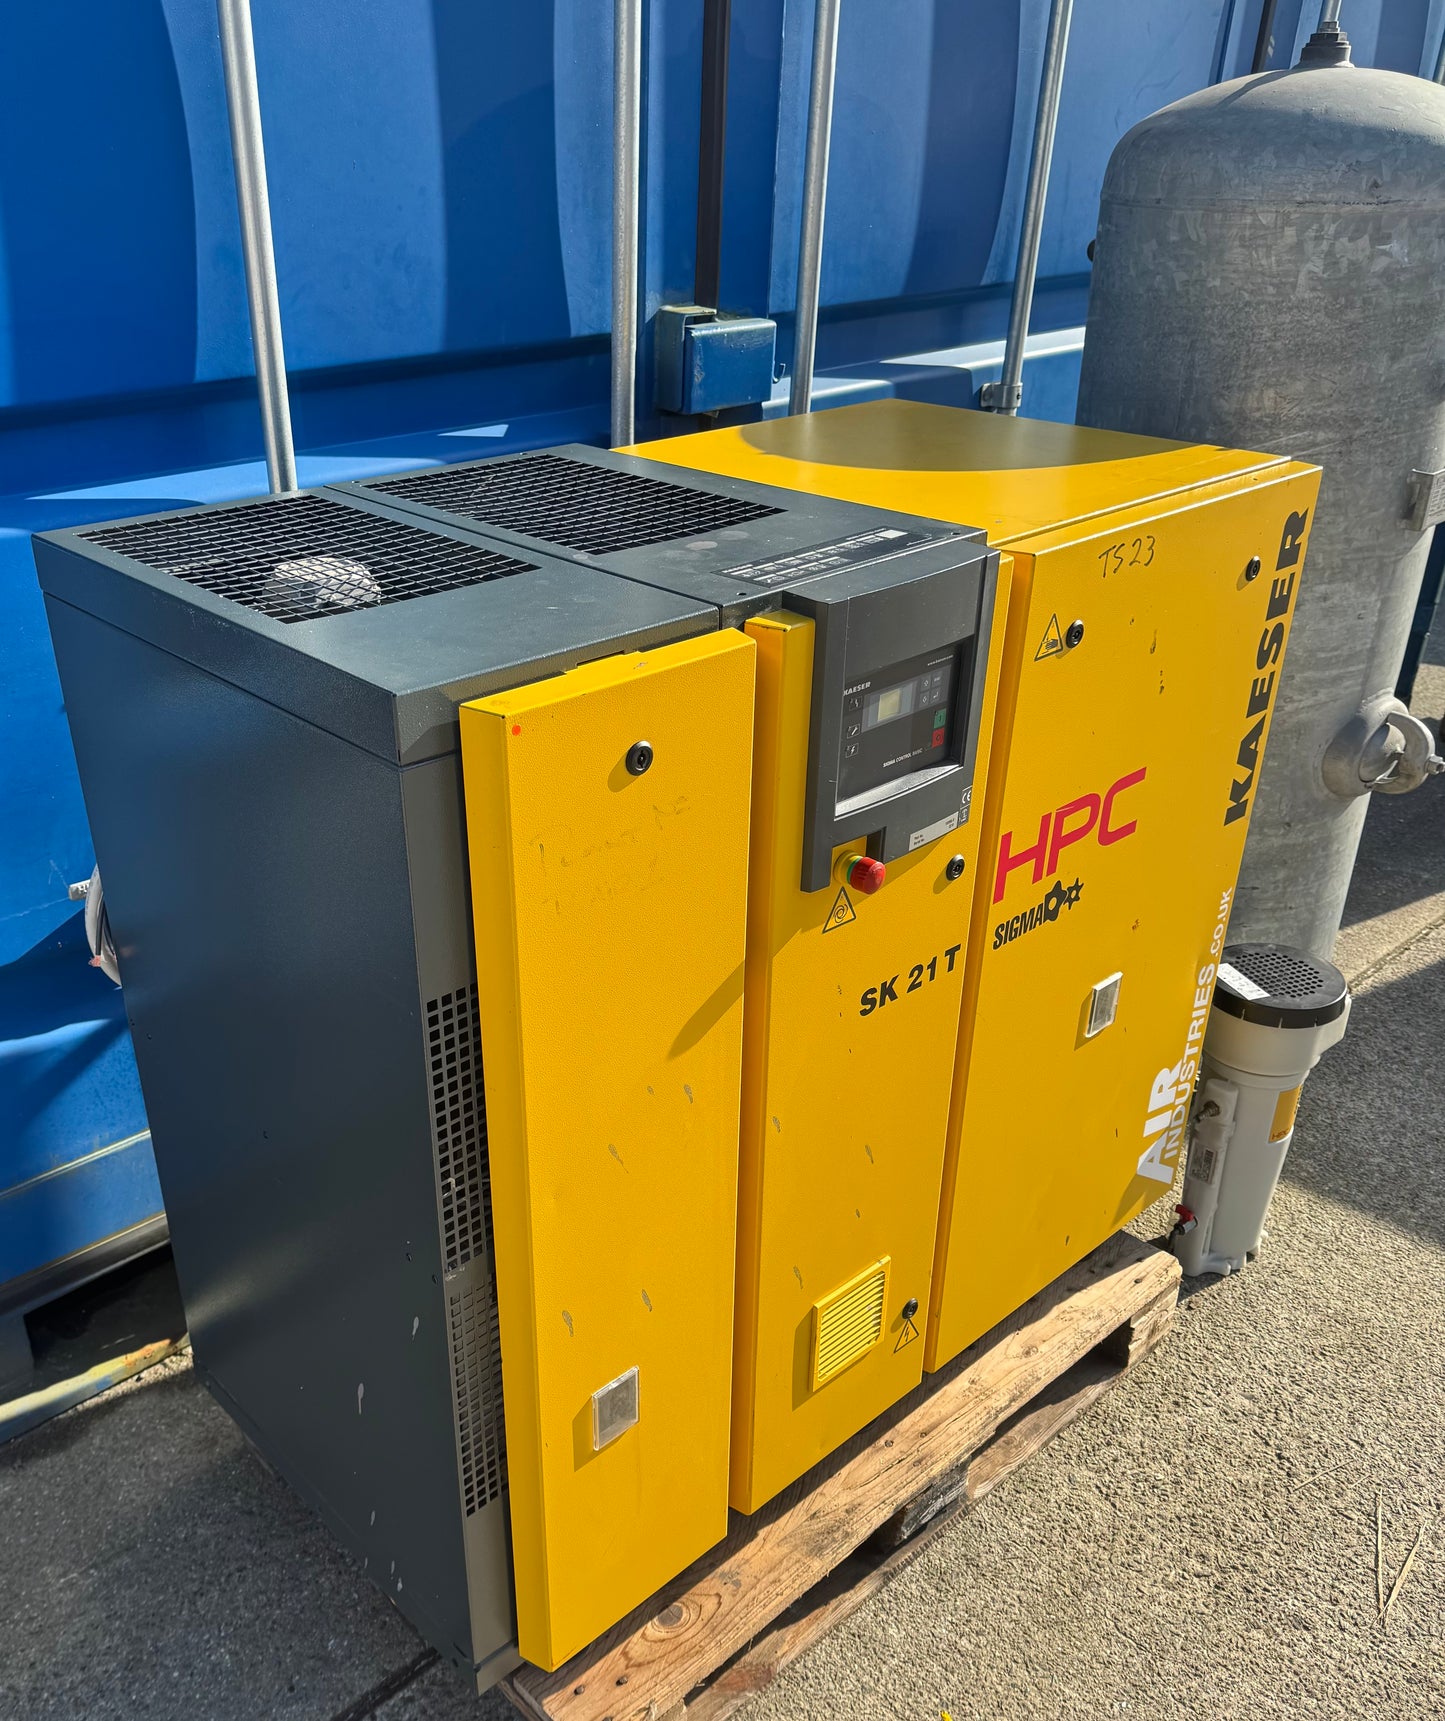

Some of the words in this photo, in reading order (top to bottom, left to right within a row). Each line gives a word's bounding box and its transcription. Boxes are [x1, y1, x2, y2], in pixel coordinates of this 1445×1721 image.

[842, 681, 871, 697] KAESER
[1224, 508, 1309, 827] KAESER
[992, 766, 1147, 905] HPC
[992, 902, 1046, 950] SIGMA
[859, 974, 900, 1017] SK
[907, 956, 938, 993] 21
[944, 944, 962, 973] T
[1136, 1057, 1184, 1185] AIR
